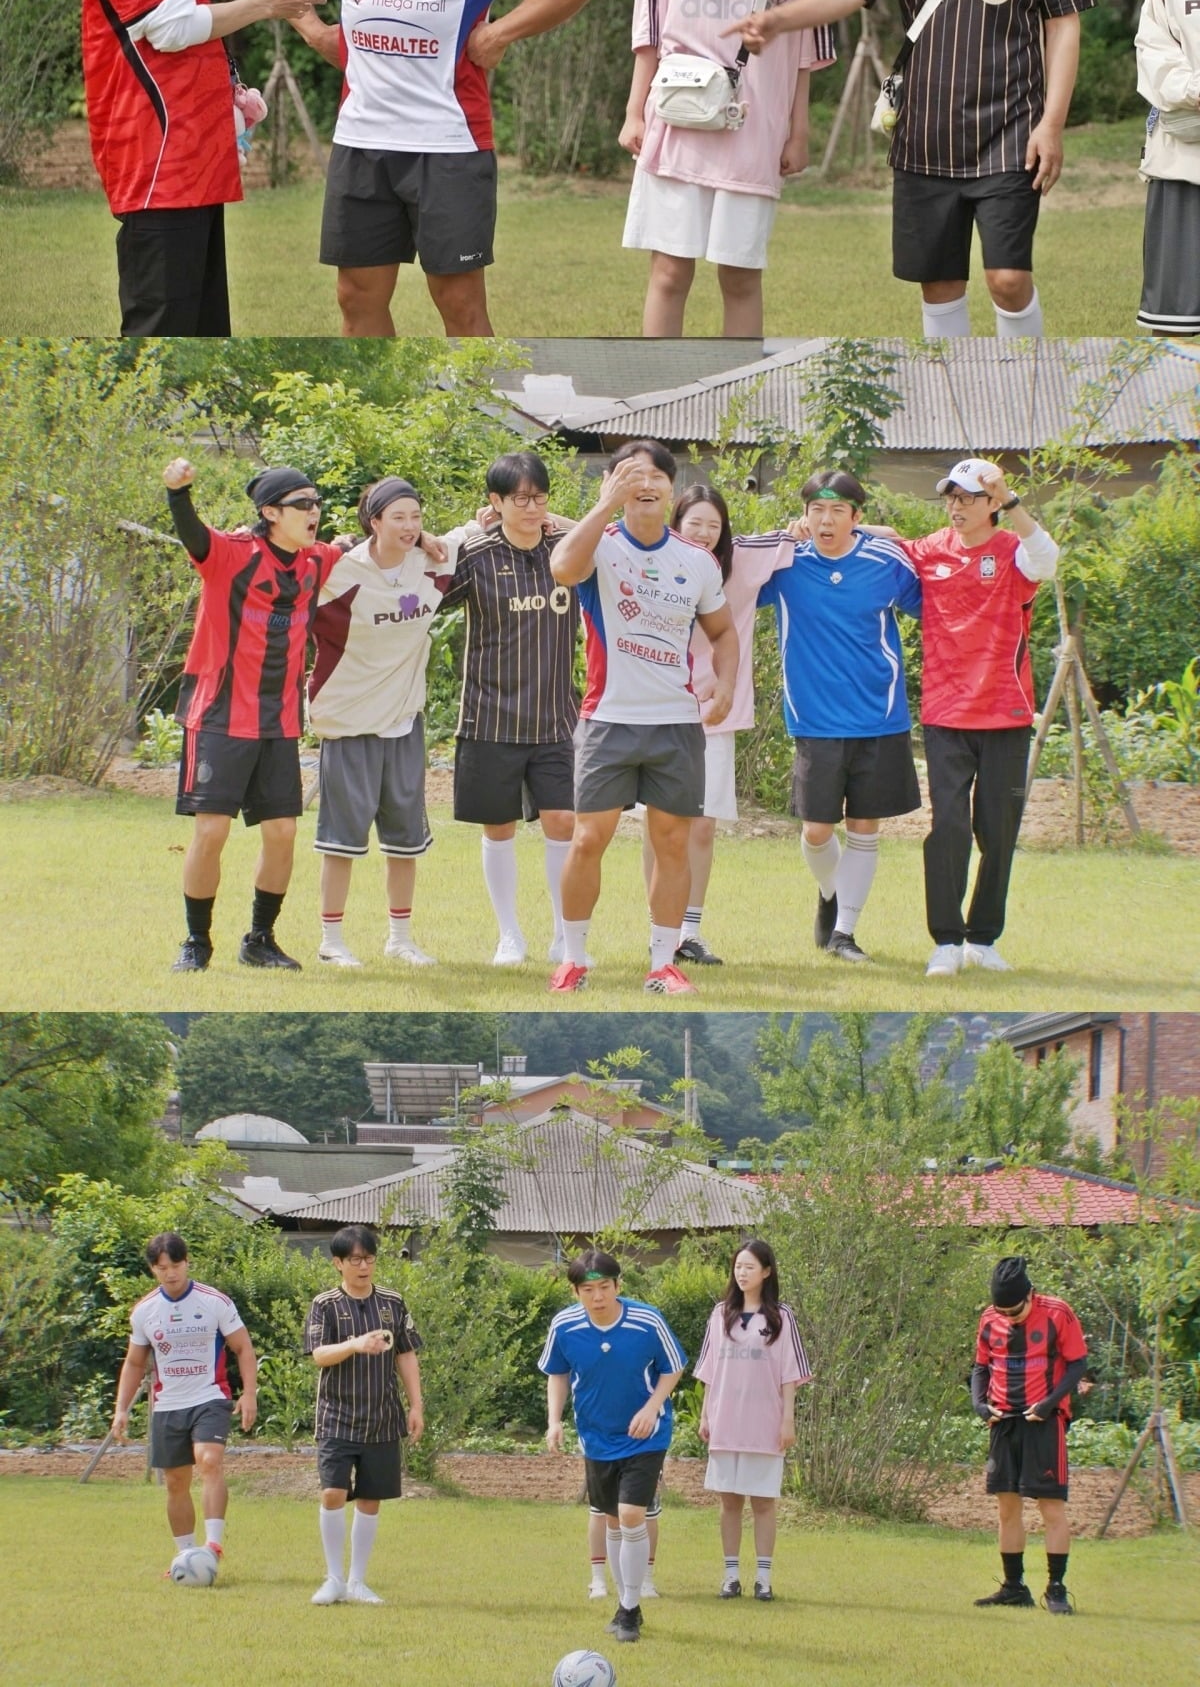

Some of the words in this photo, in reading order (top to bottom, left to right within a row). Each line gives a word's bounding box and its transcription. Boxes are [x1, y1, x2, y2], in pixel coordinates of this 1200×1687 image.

[416, 0, 446, 13] mall
[352, 29, 439, 55] GENERALTEC
[636, 584, 661, 600] SAIF
[663, 592, 692, 607] ZONE
[374, 603, 432, 626] PUMA
